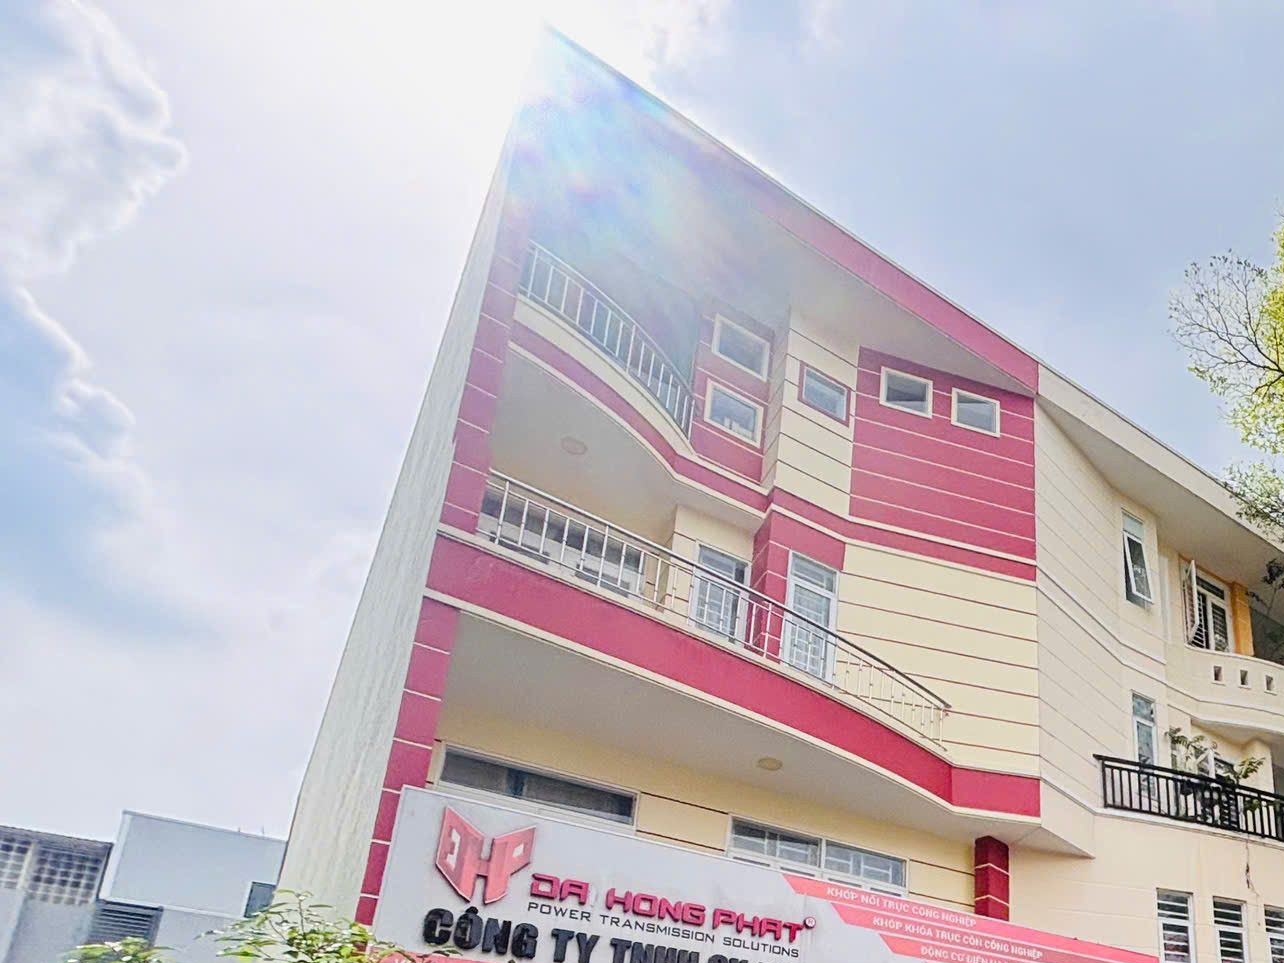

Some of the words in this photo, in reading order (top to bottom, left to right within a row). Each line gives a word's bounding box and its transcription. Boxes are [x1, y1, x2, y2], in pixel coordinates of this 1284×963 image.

[605, 888, 705, 926] HONG
[883, 898, 909, 912] TRỤC
[912, 905, 940, 919] CÔNG
[941, 911, 976, 927] NGHIỆP
[422, 906, 539, 960] CÔNG
[527, 901, 591, 922] POWER
[600, 914, 715, 944] TRANSMISSION
[723, 936, 799, 958] SOLUTIONS
[935, 929, 961, 943] TRỤC
[984, 940, 1009, 953] CÔNG
[1010, 944, 1043, 960] NGHIỆP
[920, 945, 948, 960] ĐỘNG
